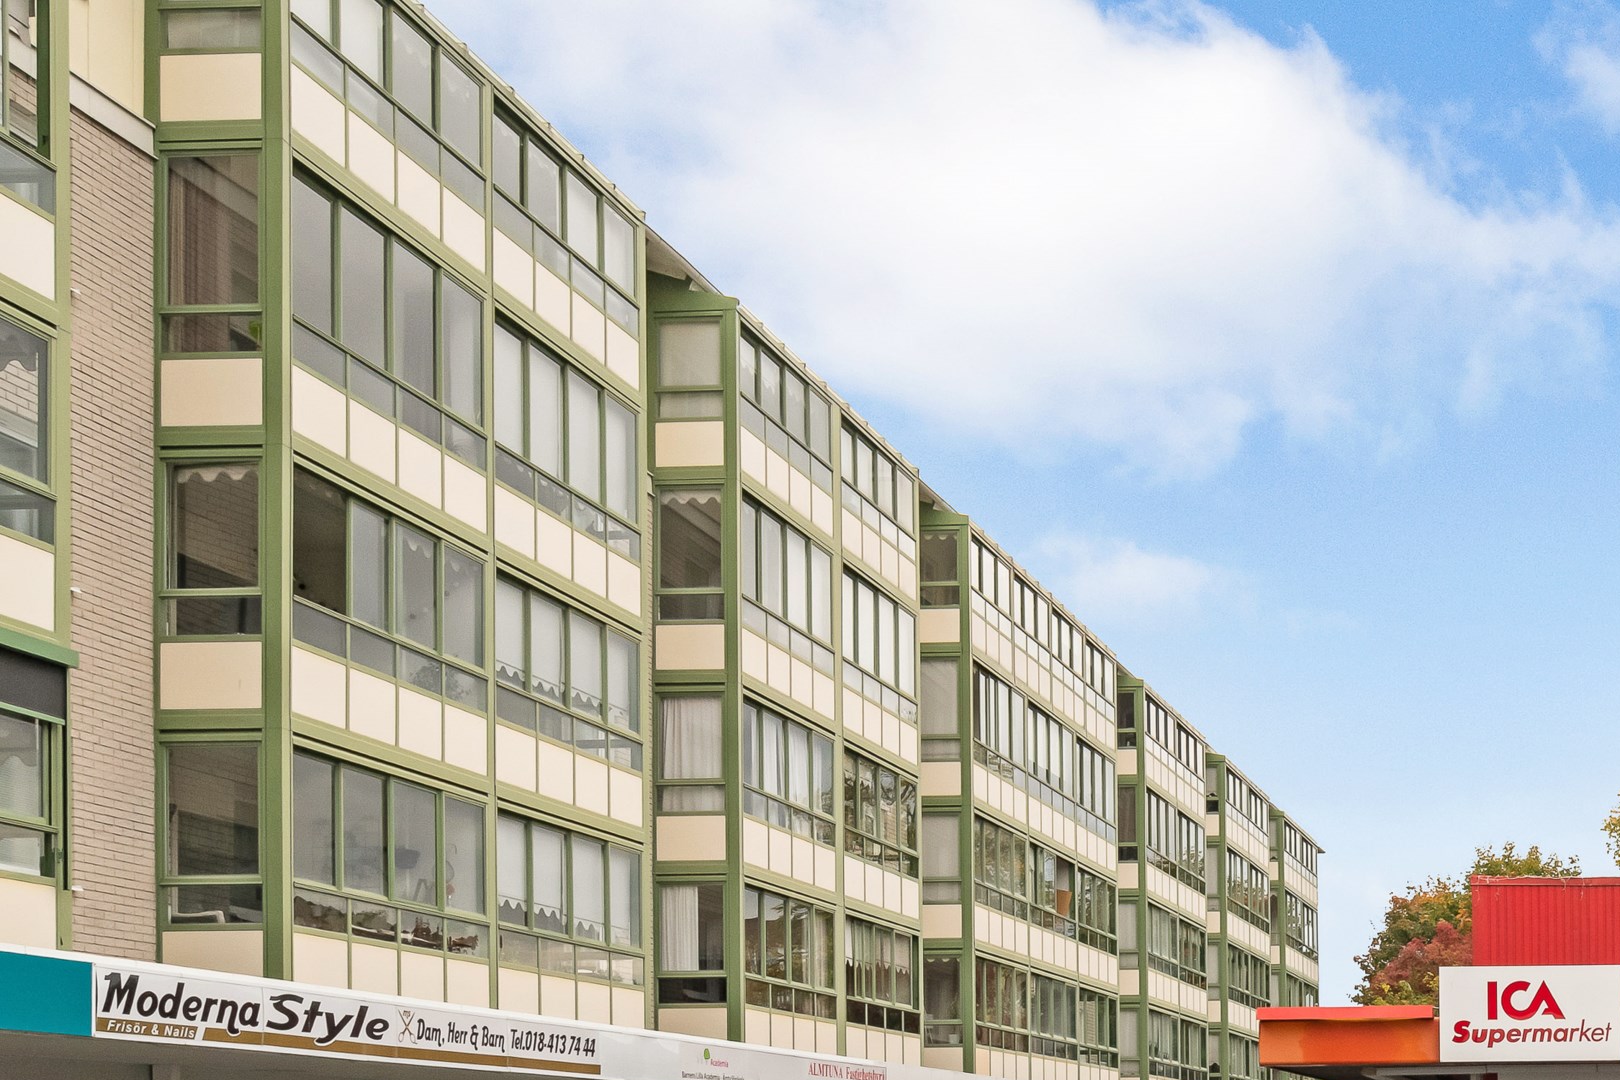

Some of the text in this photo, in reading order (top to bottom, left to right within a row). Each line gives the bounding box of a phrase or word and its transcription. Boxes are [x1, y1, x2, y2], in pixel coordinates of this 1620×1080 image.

[102, 971, 390, 1044] Moderna Style
[1487, 979, 1566, 1021] ICA
[106, 1019, 195, 1039] Frisör & Nails
[416, 1018, 506, 1053] Dam, Herr & Barn
[1451, 1019, 1612, 1048] Supermarket
[808, 1062, 843, 1079] ALMTUNA
